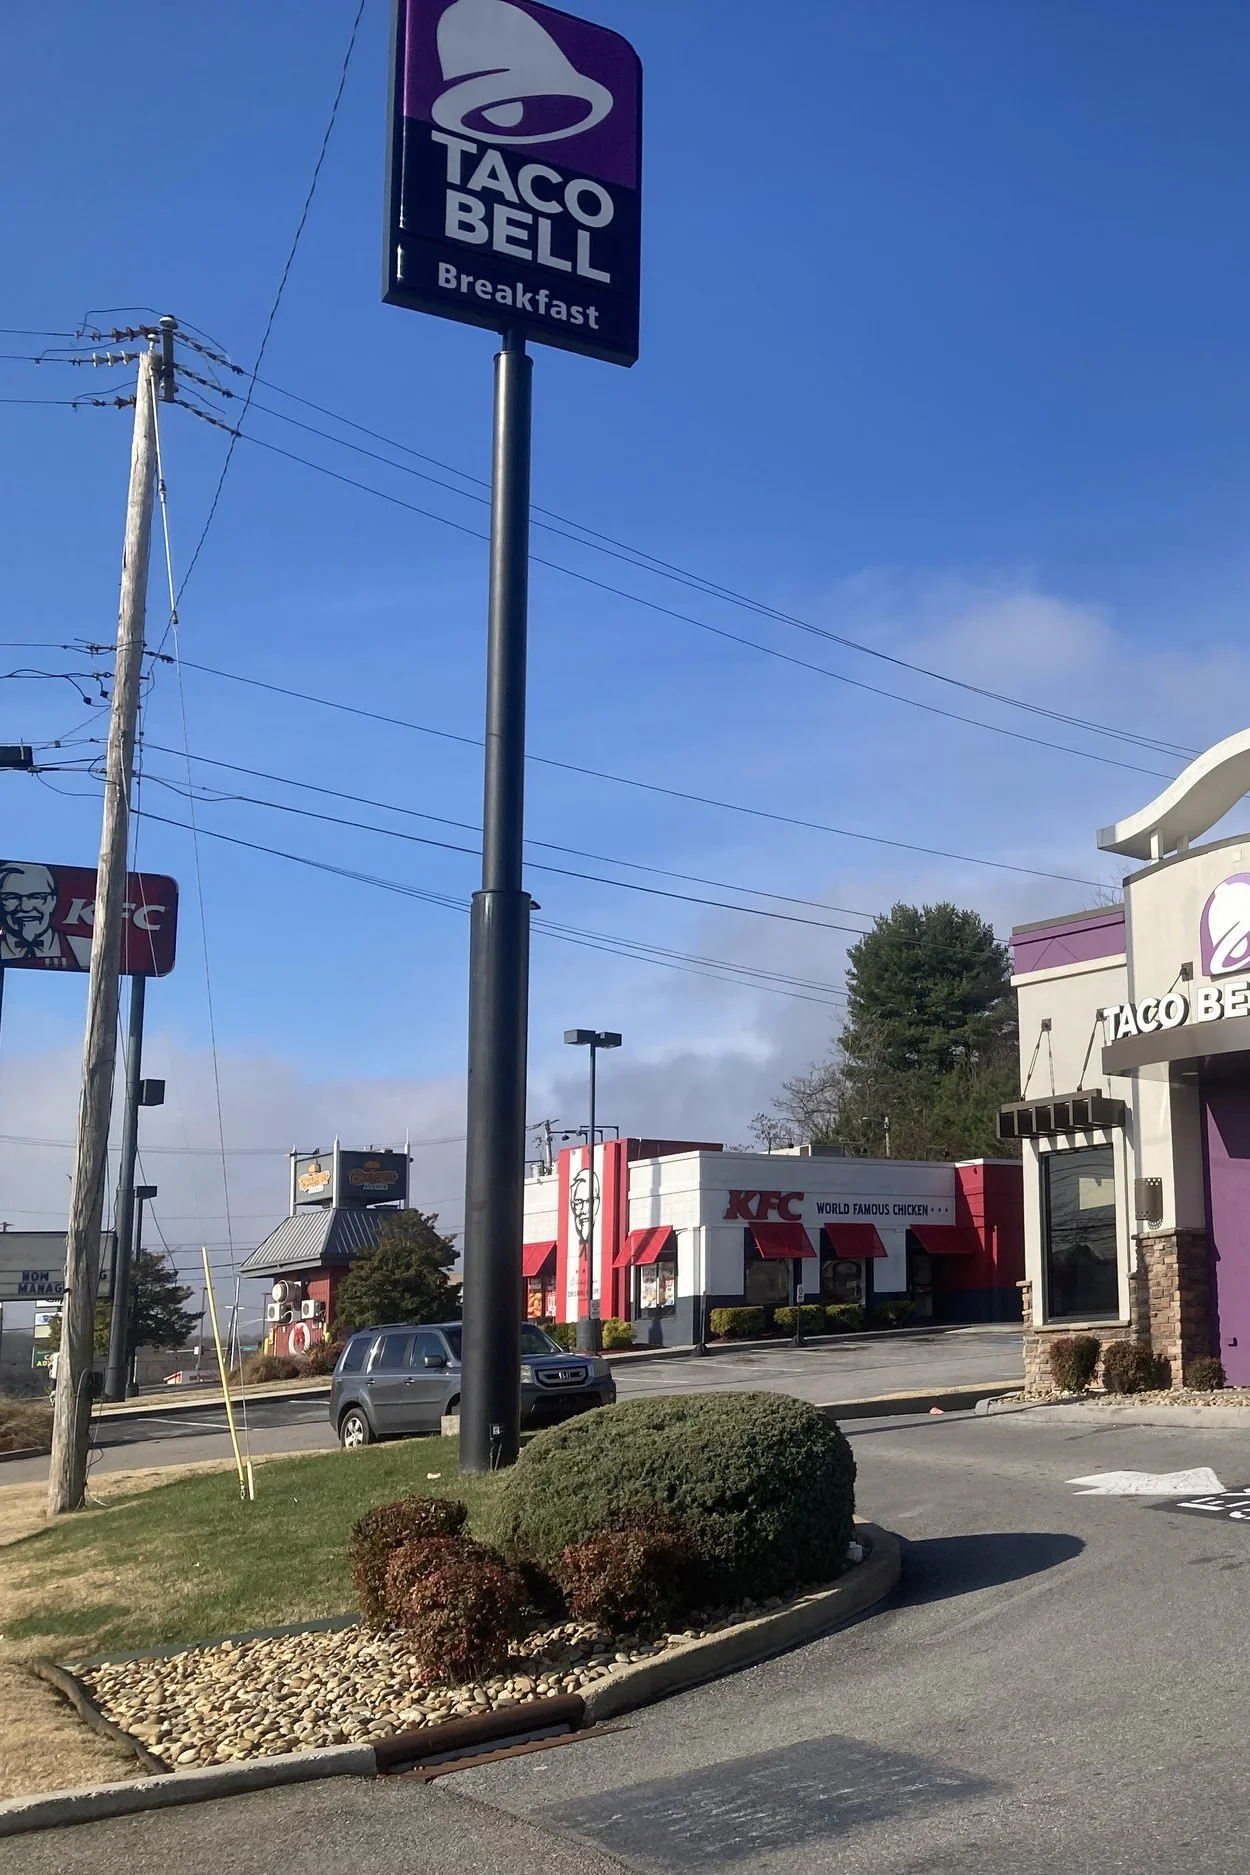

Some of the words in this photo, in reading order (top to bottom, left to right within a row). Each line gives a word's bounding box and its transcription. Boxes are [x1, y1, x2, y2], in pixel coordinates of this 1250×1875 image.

[431, 130, 614, 228] TACO
[445, 188, 611, 283] BELL
[438, 262, 599, 329] Breakfast
[1103, 991, 1188, 1041] TACO
[723, 1190, 805, 1221] KFC
[816, 1202, 850, 1215] WORLD
[853, 1202, 890, 1216] FAMOUS
[892, 1203, 928, 1216] CHICKEN
[18, 1282, 64, 1295] MANAG
[22, 1271, 49, 1282] NOW
